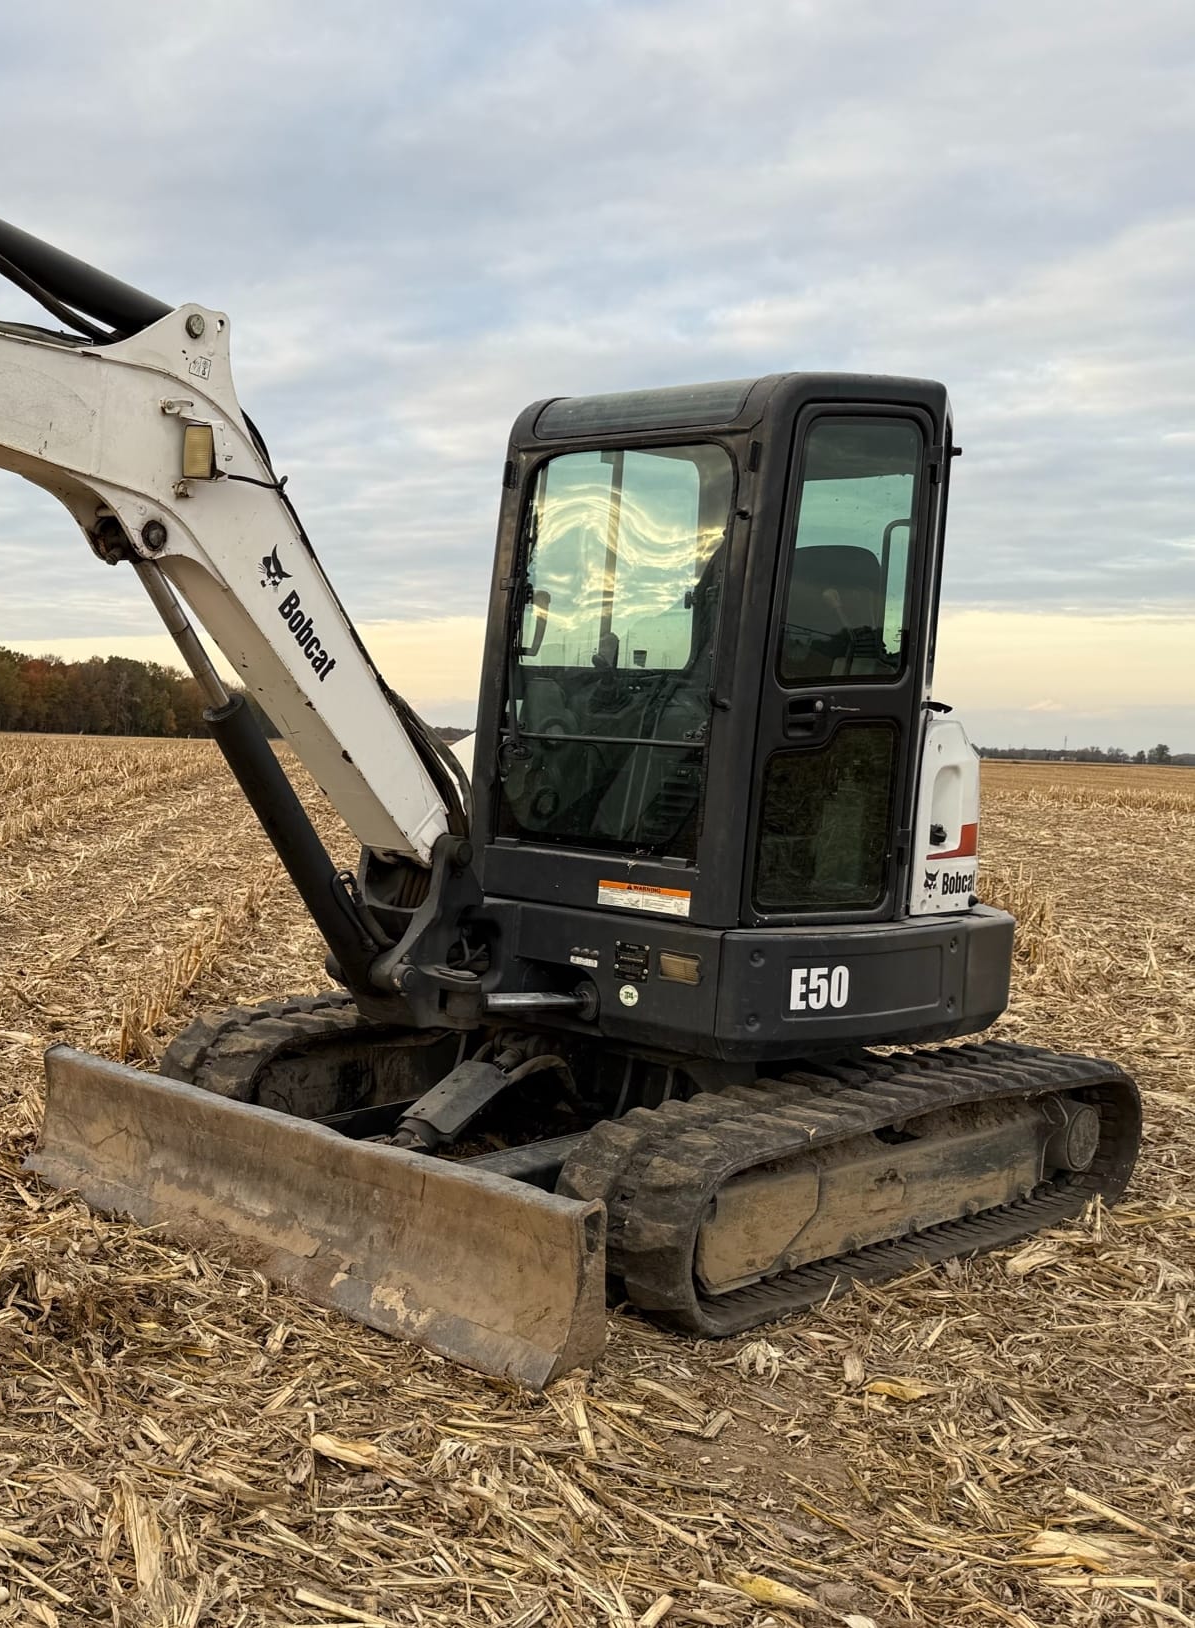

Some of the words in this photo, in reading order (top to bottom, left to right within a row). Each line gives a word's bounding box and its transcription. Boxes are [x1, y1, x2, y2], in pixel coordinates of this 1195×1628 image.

[278, 589, 336, 682] Bobcat
[633, 885, 661, 894] WARNING
[790, 965, 849, 1010] E50
